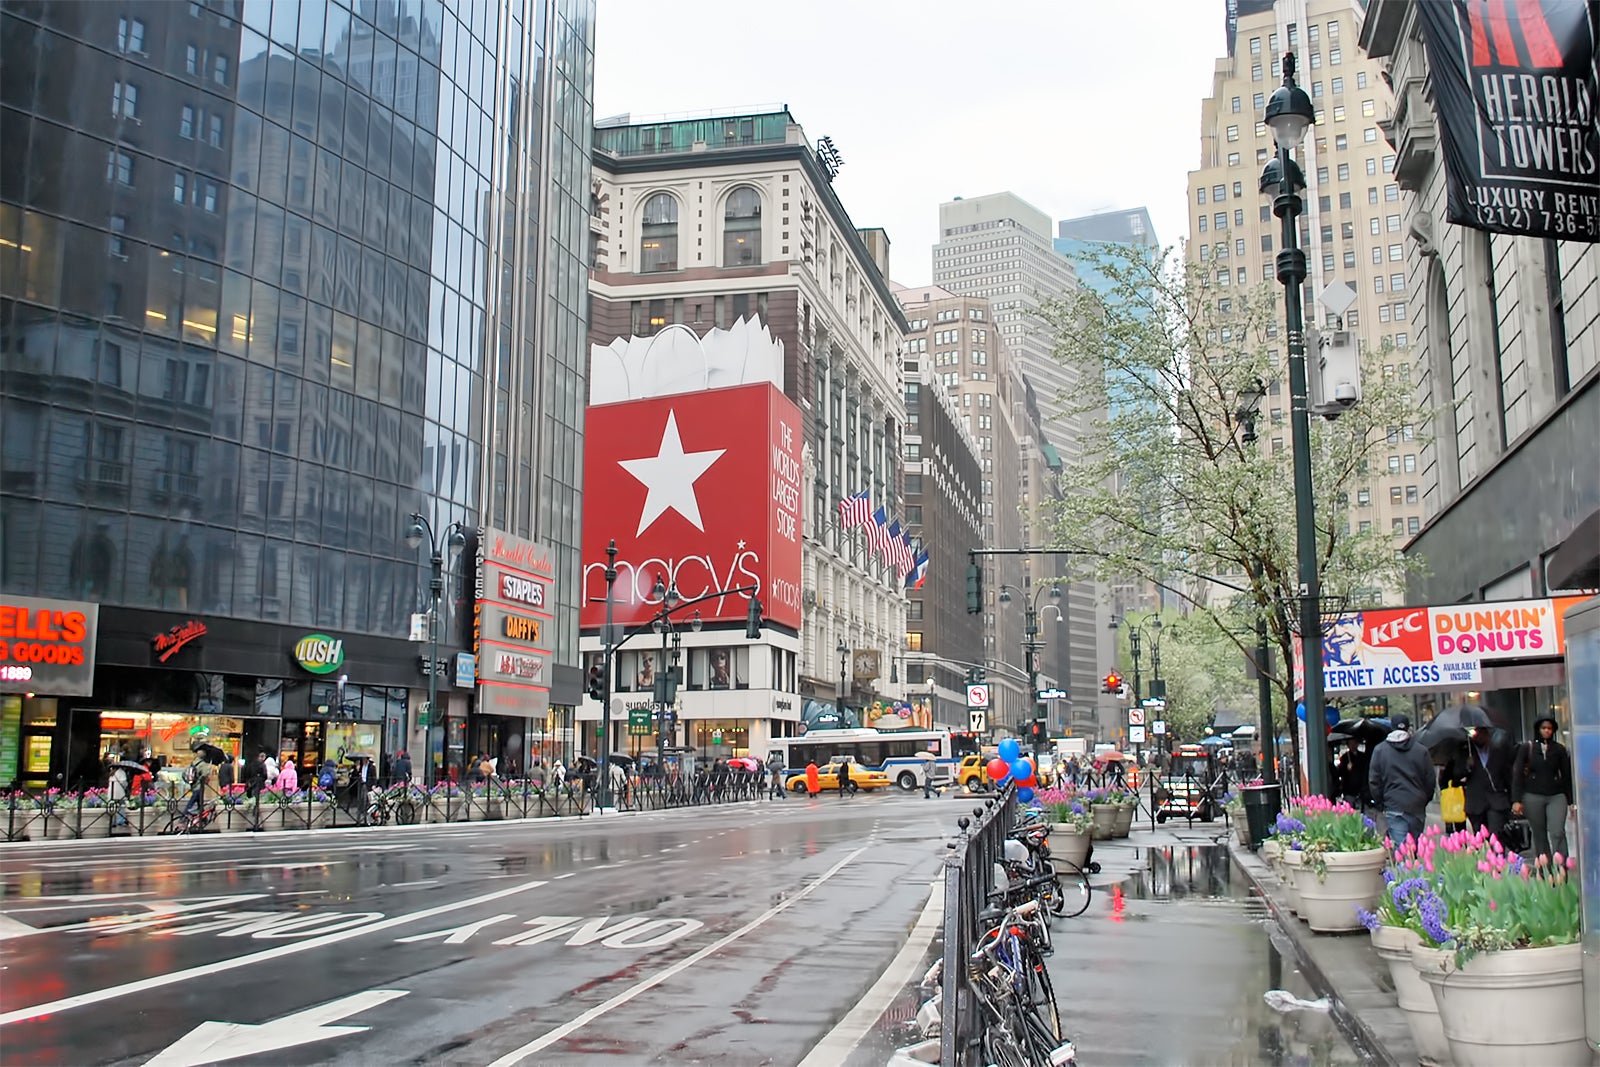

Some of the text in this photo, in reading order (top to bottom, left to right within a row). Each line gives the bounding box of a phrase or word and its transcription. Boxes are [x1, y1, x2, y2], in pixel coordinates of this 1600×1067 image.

[1481, 74, 1591, 126] HERALD
[1492, 125, 1596, 175] TOWERS
[1465, 185, 1545, 211] LUXURY
[1477, 205, 1531, 231] (212)
[780, 420, 793, 454] THE
[772, 473, 800, 515] LARGEST
[776, 507, 796, 543] STORE
[475, 526, 485, 599] STAPLES
[503, 575, 543, 606] STAPLES
[507, 614, 540, 642] DAFFY'S
[1369, 612, 1423, 646] KFC
[1435, 607, 1547, 634] DUNKIN'
[13, 641, 85, 667] GOODS
[298, 639, 343, 664] LUSH
[1437, 628, 1544, 656] DONUTS
[1383, 664, 1440, 685] ACCESS
[1442, 661, 1478, 672] AVAILABLE
[1449, 671, 1473, 681] INSIDE
[625, 698, 661, 711] sunglas
